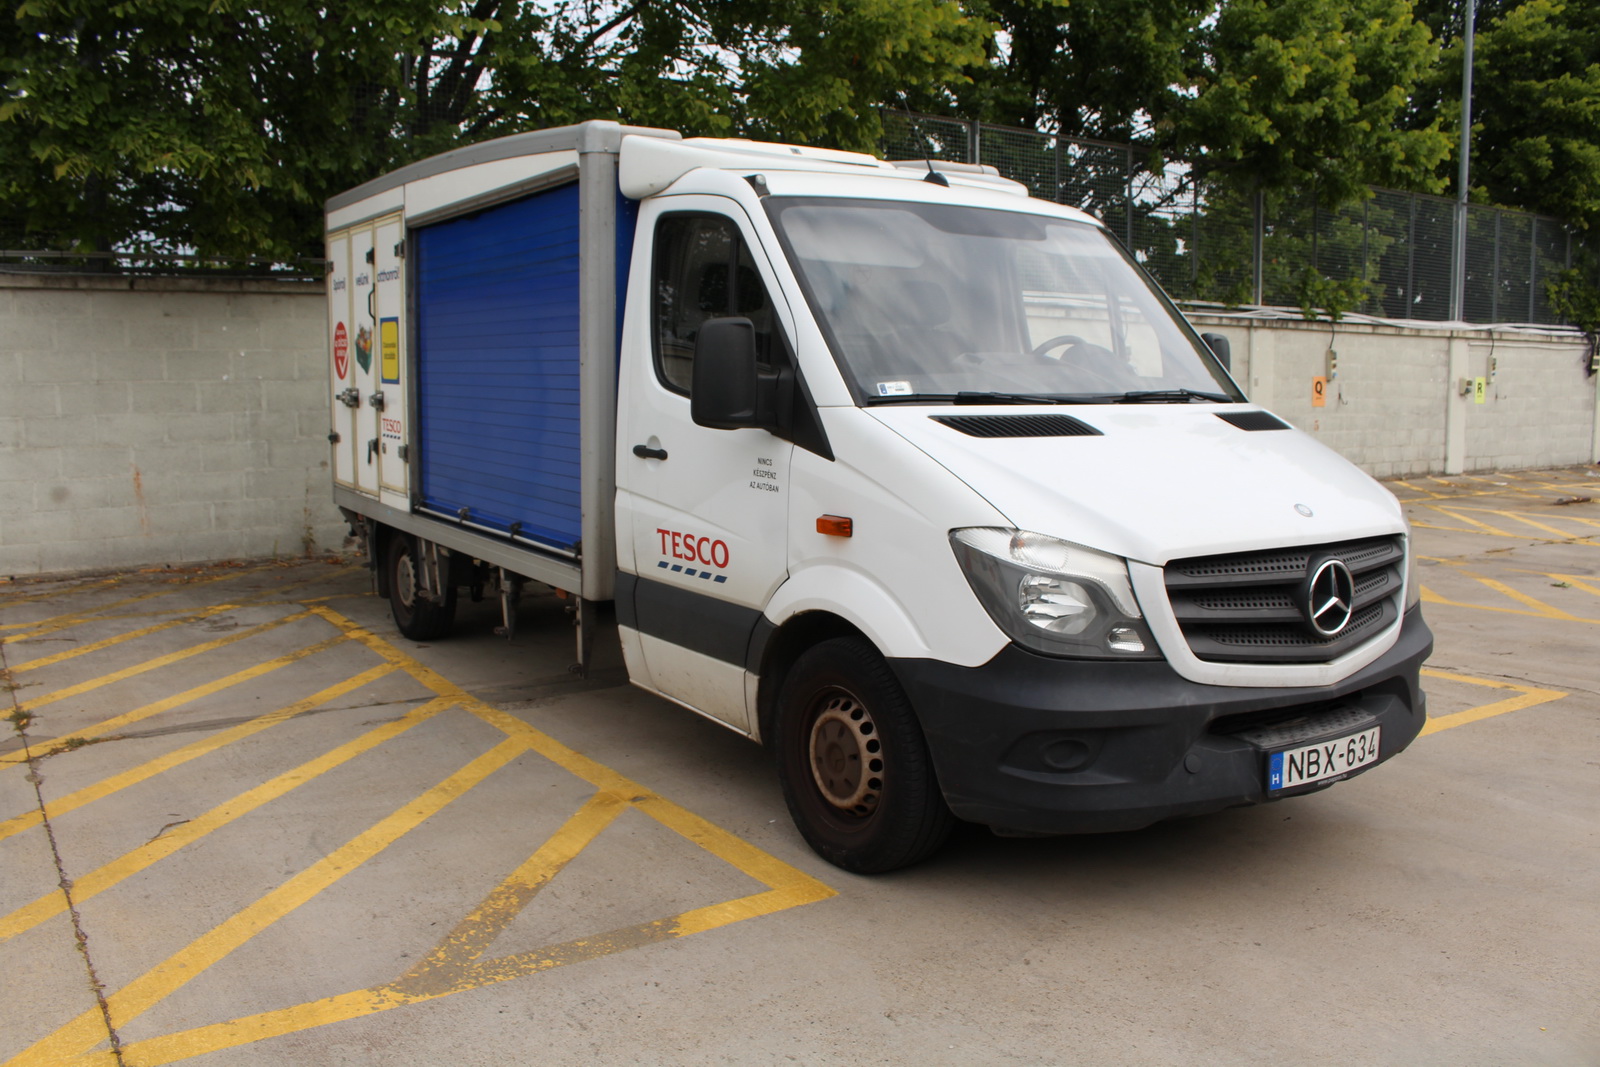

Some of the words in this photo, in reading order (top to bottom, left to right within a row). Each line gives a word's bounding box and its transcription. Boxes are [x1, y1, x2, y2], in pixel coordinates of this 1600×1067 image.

[1314, 380, 1323, 396] Q
[1477, 382, 1483, 394] R
[382, 418, 402, 434] TESCO
[757, 457, 773, 467] NINCS
[753, 468, 777, 480] KÉSZPÉNZ
[749, 481, 756, 489] AZ
[757, 481, 780, 493] AUTÓBAN
[656, 528, 730, 569] TESCO
[1271, 773, 1280, 785] H
[1288, 731, 1377, 783] NBX-634
